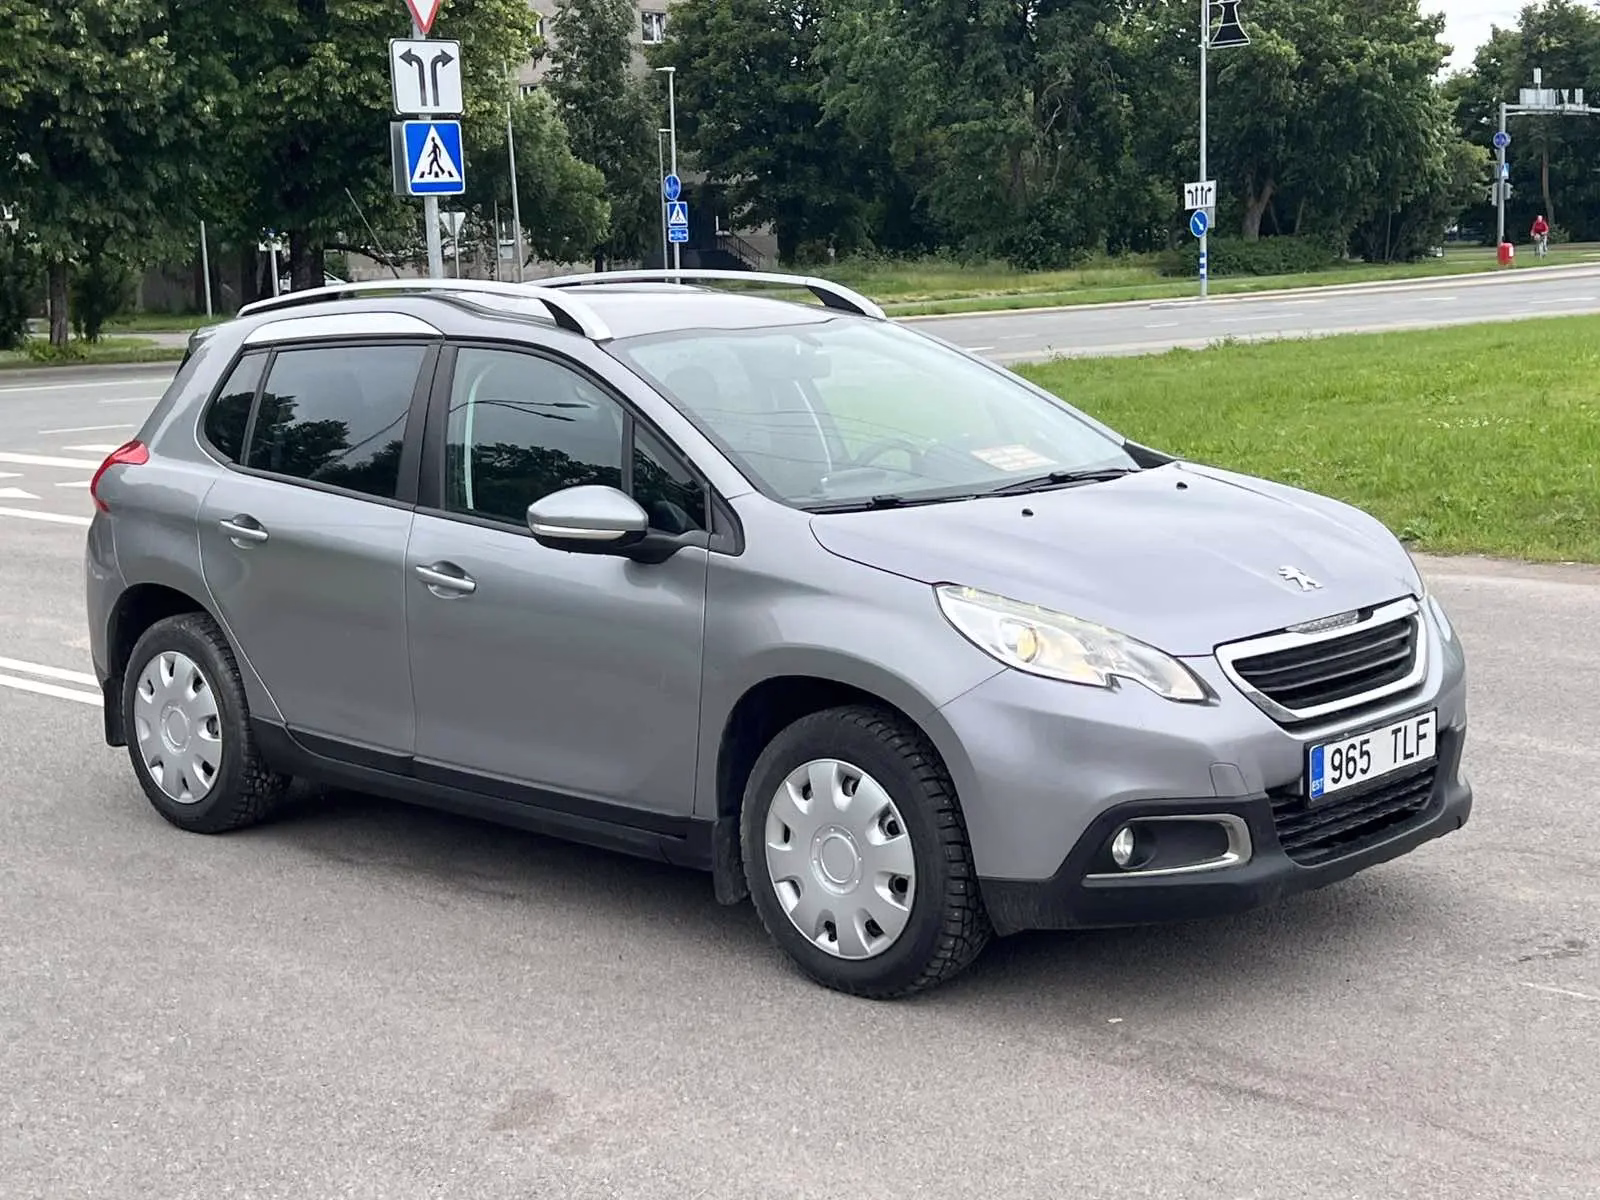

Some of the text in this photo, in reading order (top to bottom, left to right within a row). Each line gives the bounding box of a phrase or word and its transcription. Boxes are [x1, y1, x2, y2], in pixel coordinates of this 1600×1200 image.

[1331, 717, 1430, 784] 965 TLF
[1312, 778, 1324, 791] EST
